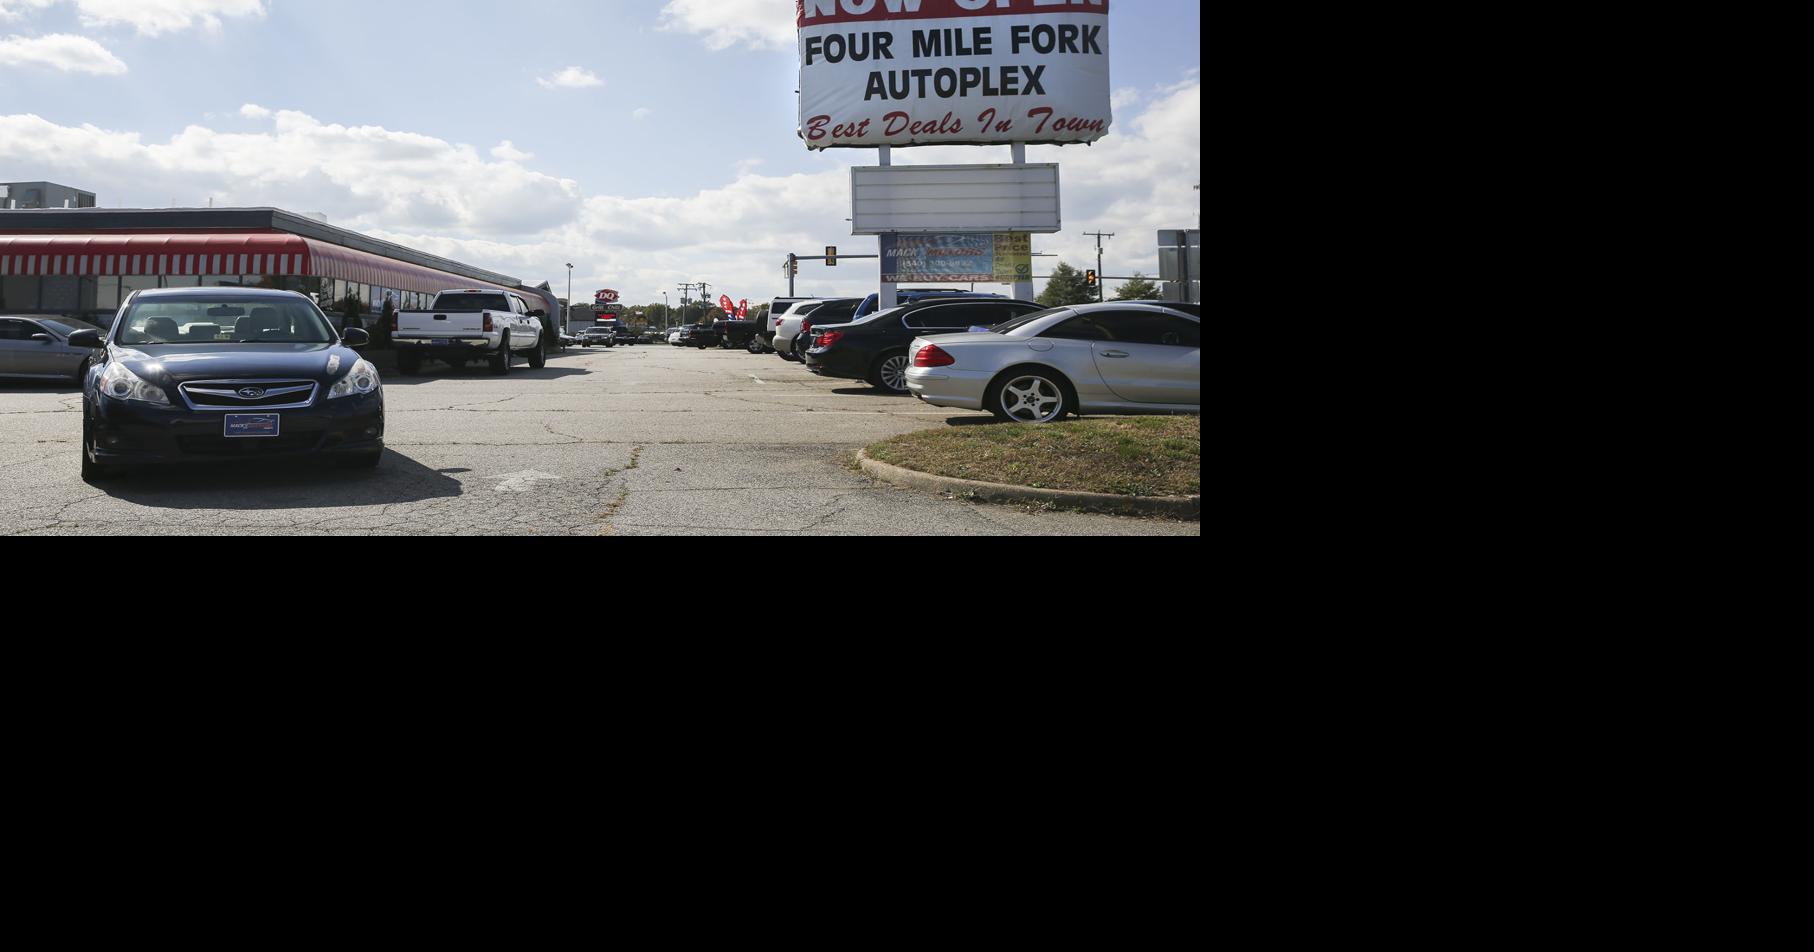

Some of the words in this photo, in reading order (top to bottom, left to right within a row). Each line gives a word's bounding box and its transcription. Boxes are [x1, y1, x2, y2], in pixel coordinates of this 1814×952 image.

[805, 31, 894, 66] FOUR
[912, 27, 993, 58] MILE
[1011, 24, 1102, 55] FORK
[863, 65, 1046, 101] AUTOPLEX
[807, 114, 871, 140] Best
[883, 111, 964, 137] Deals
[977, 107, 1013, 134] In
[1027, 106, 1105, 134] Town
[886, 249, 918, 257] MACK
[946, 274, 988, 282] CARS
[599, 292, 615, 300] DQ
